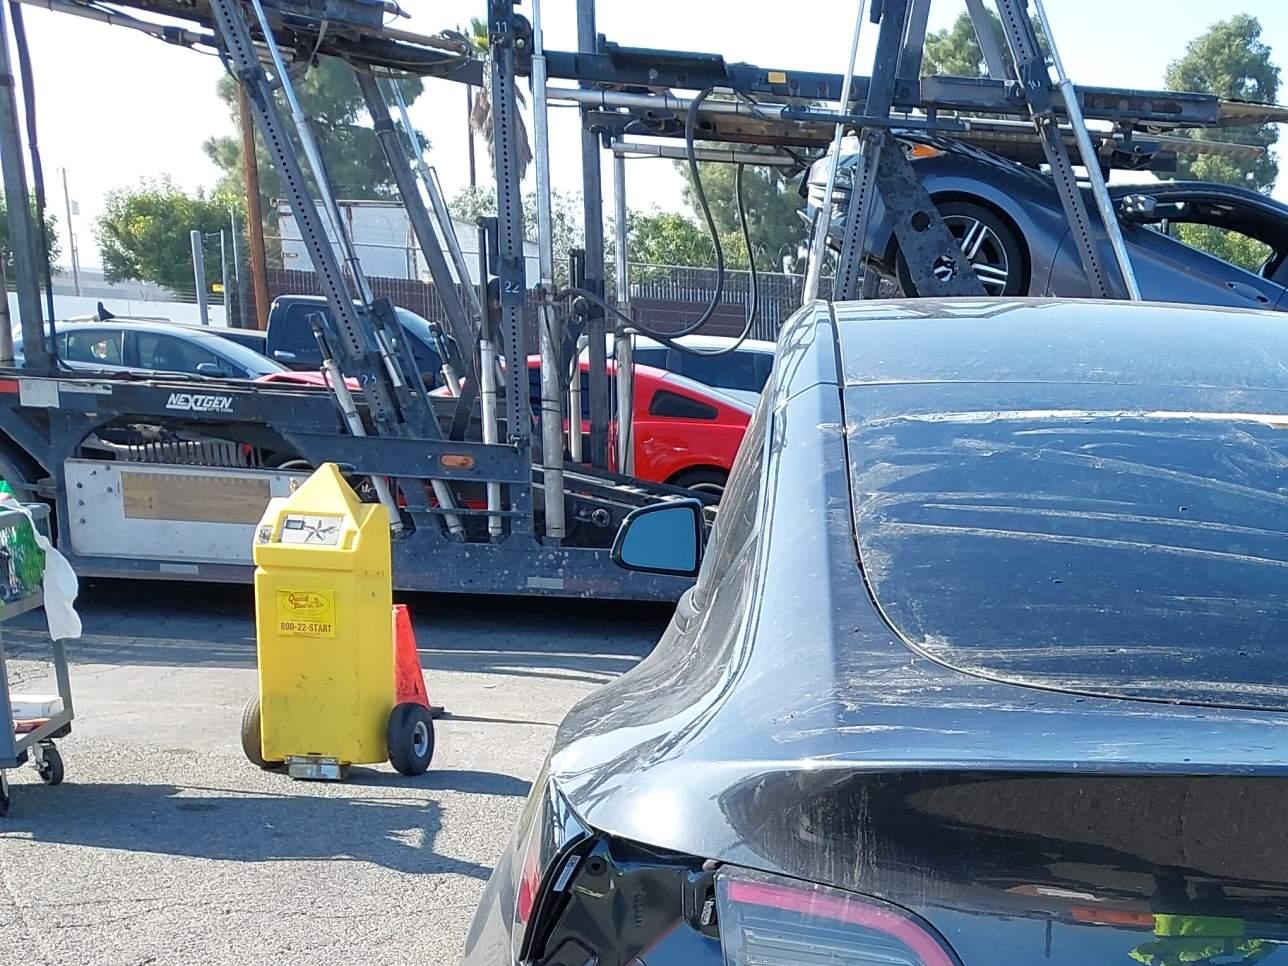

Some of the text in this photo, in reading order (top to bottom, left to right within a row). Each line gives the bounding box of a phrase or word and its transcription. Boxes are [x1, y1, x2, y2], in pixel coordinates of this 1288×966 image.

[495, 20, 507, 33] 11
[503, 280, 520, 294] 22
[166, 393, 233, 412] NEXTGEN
